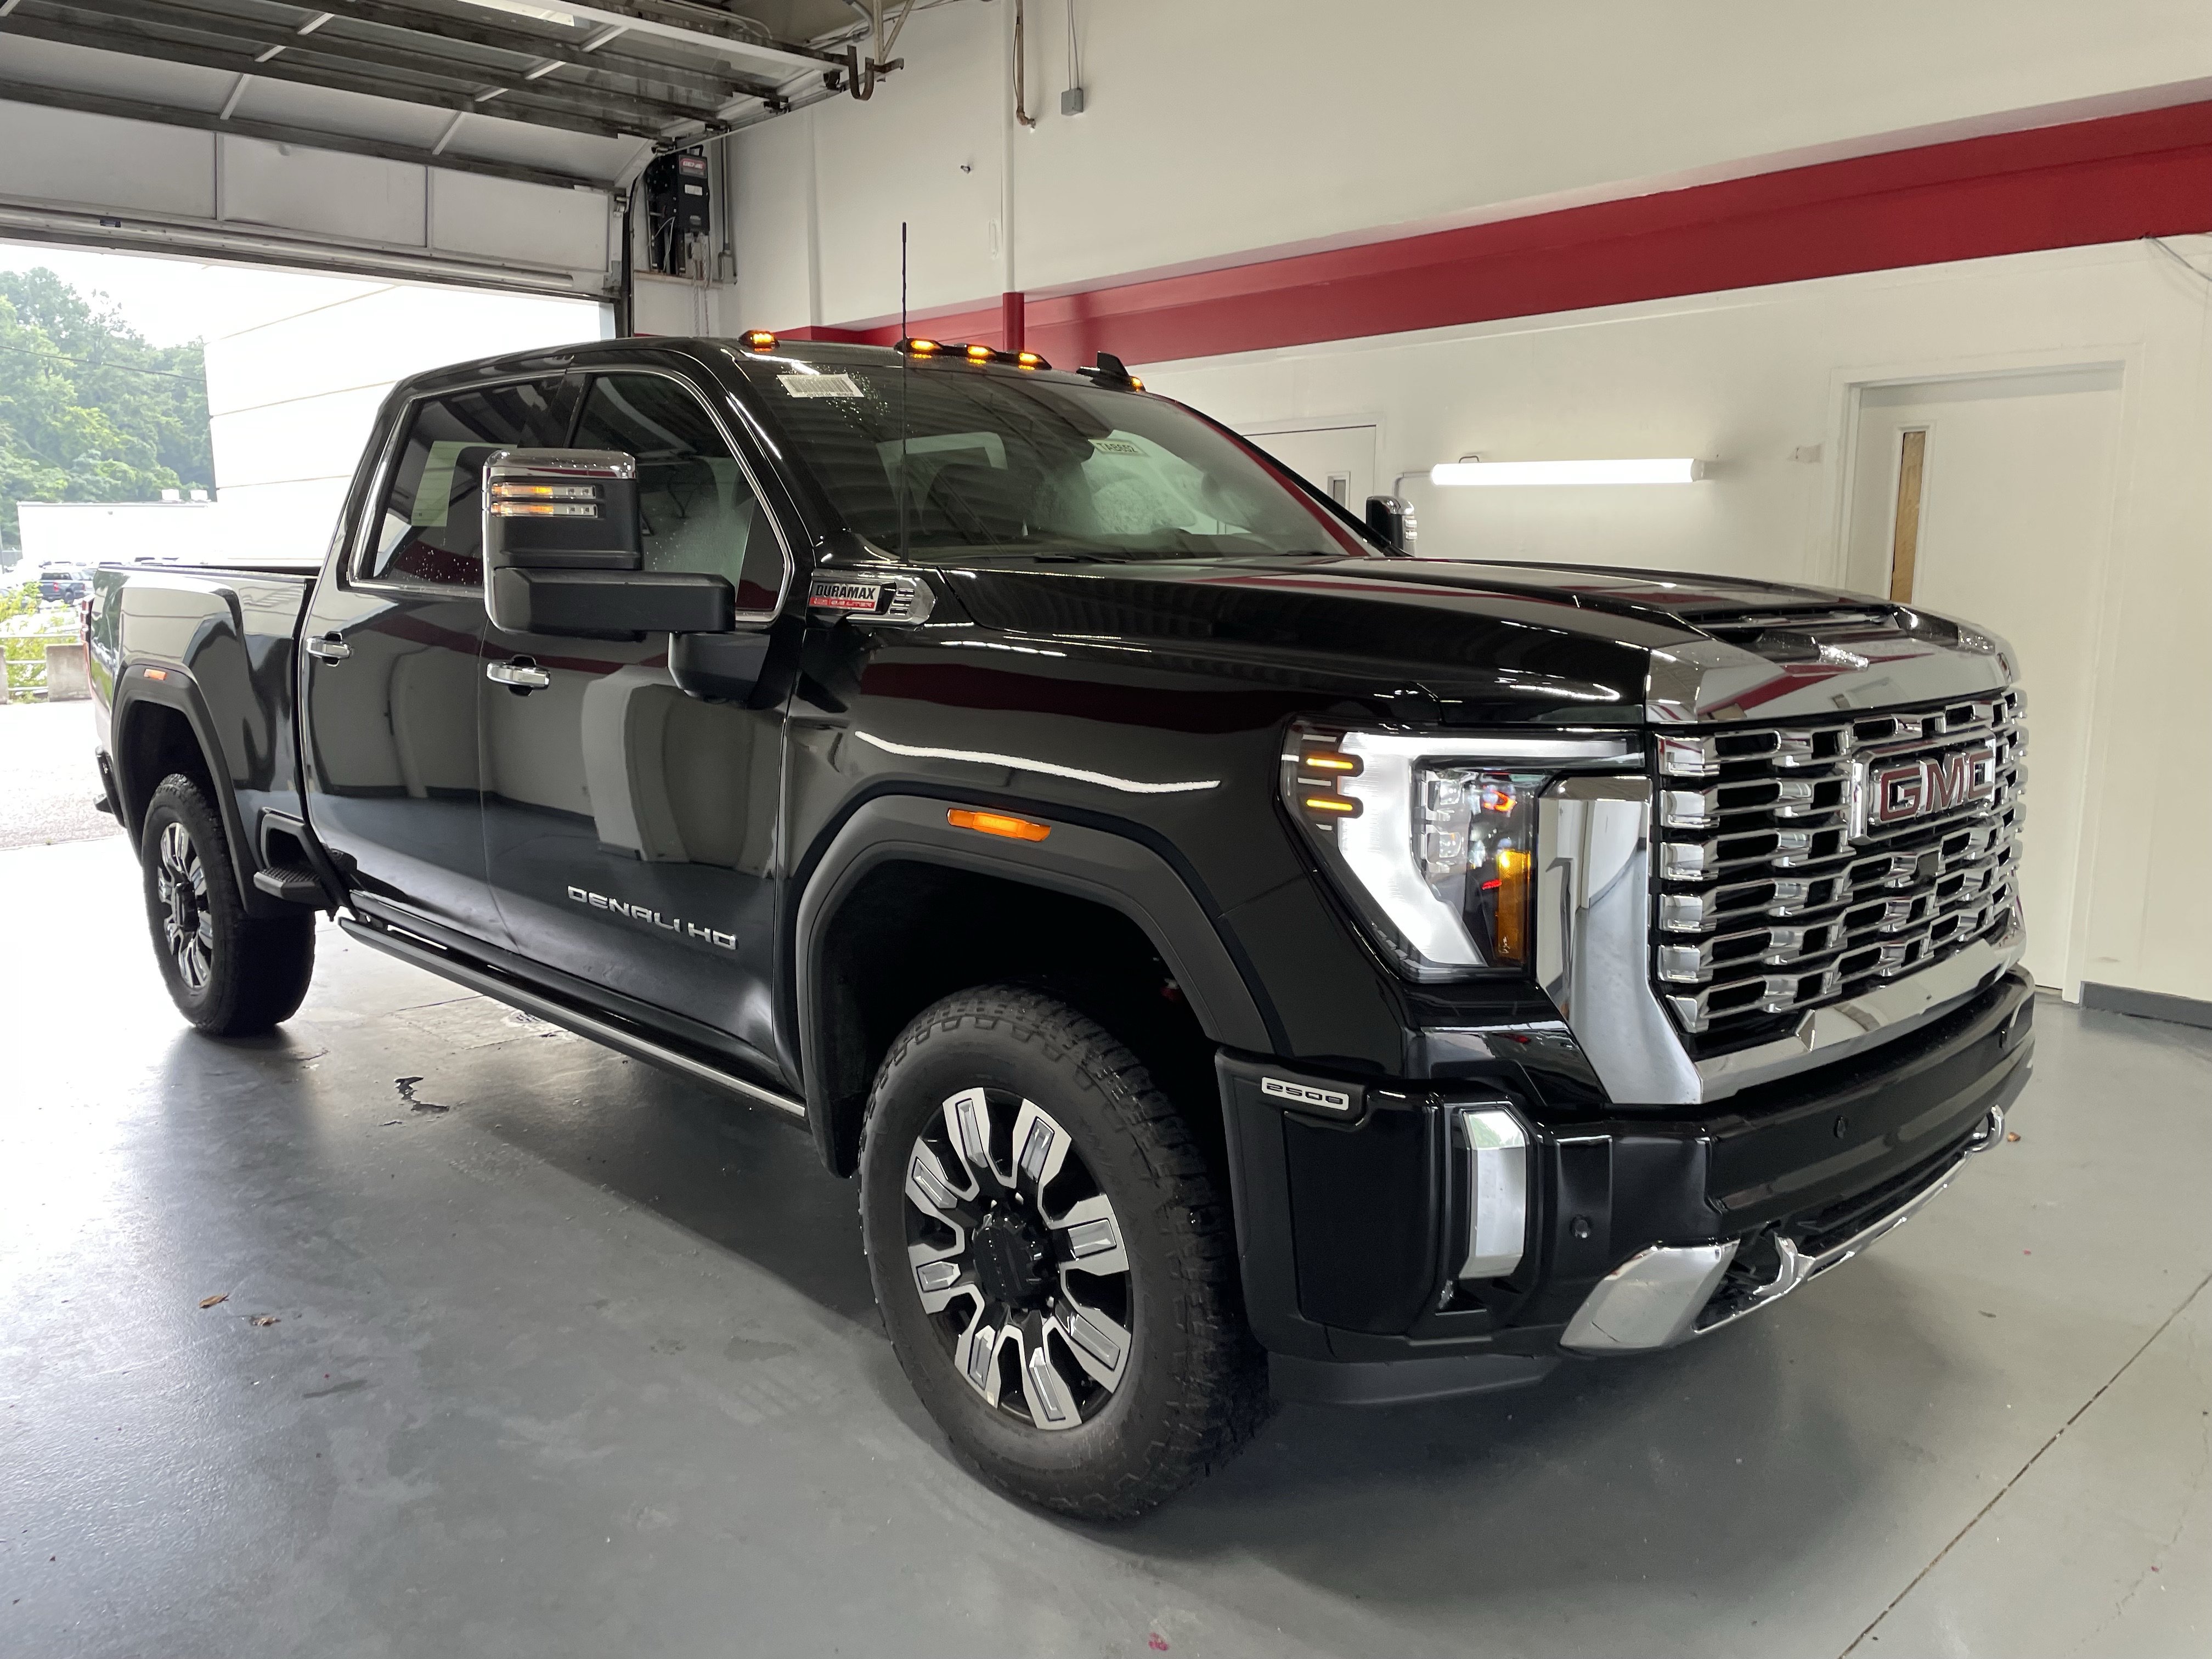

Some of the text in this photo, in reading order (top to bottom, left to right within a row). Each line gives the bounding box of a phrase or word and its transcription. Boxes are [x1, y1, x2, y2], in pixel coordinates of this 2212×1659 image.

[815, 584, 877, 600] DURAMAX
[1878, 749, 1995, 823] GMC
[567, 885, 738, 951] DENALI HD
[1266, 1082, 1344, 1105] 2500
